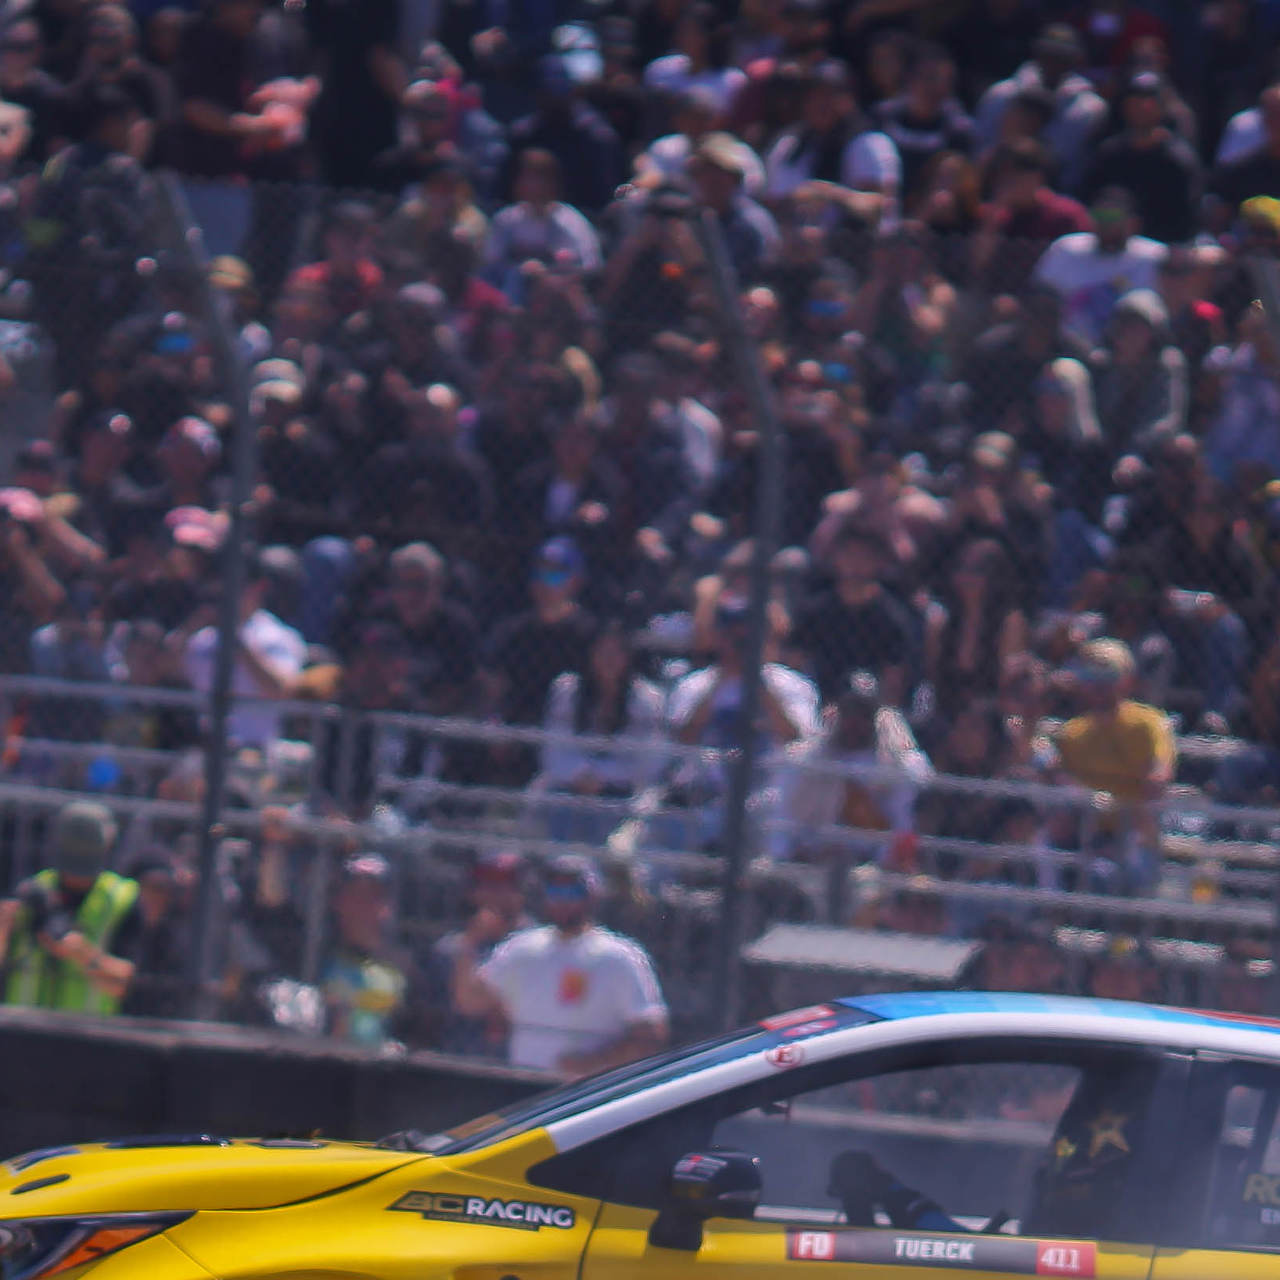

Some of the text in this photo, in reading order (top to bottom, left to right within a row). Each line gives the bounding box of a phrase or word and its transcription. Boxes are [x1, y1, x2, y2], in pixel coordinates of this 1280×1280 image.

[466, 1197, 573, 1228] RACING
[797, 1230, 1081, 1271] FD TUERCK 411
